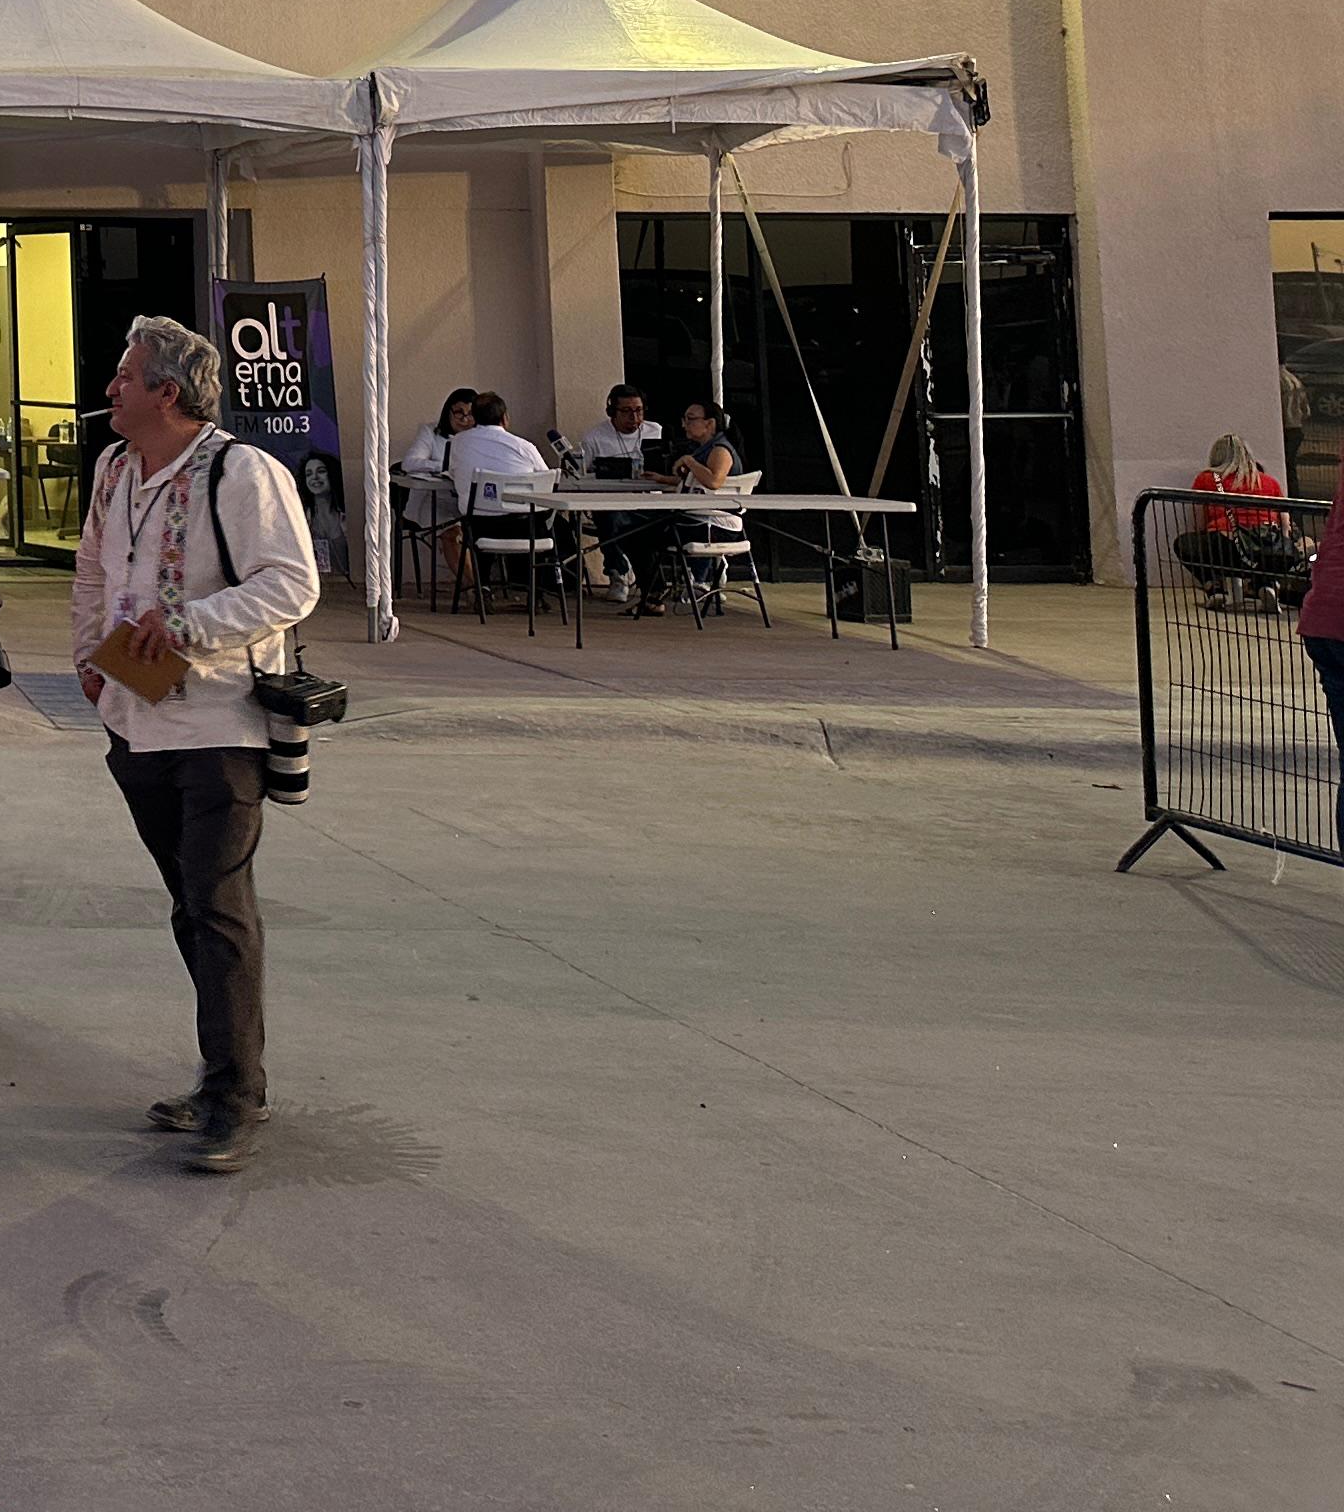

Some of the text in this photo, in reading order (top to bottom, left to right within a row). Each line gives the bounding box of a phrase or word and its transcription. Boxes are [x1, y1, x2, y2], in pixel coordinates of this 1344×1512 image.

[231, 301, 304, 361] alt
[235, 360, 302, 384] erna
[237, 383, 304, 408] tiva
[235, 415, 311, 434] FM 100.3
